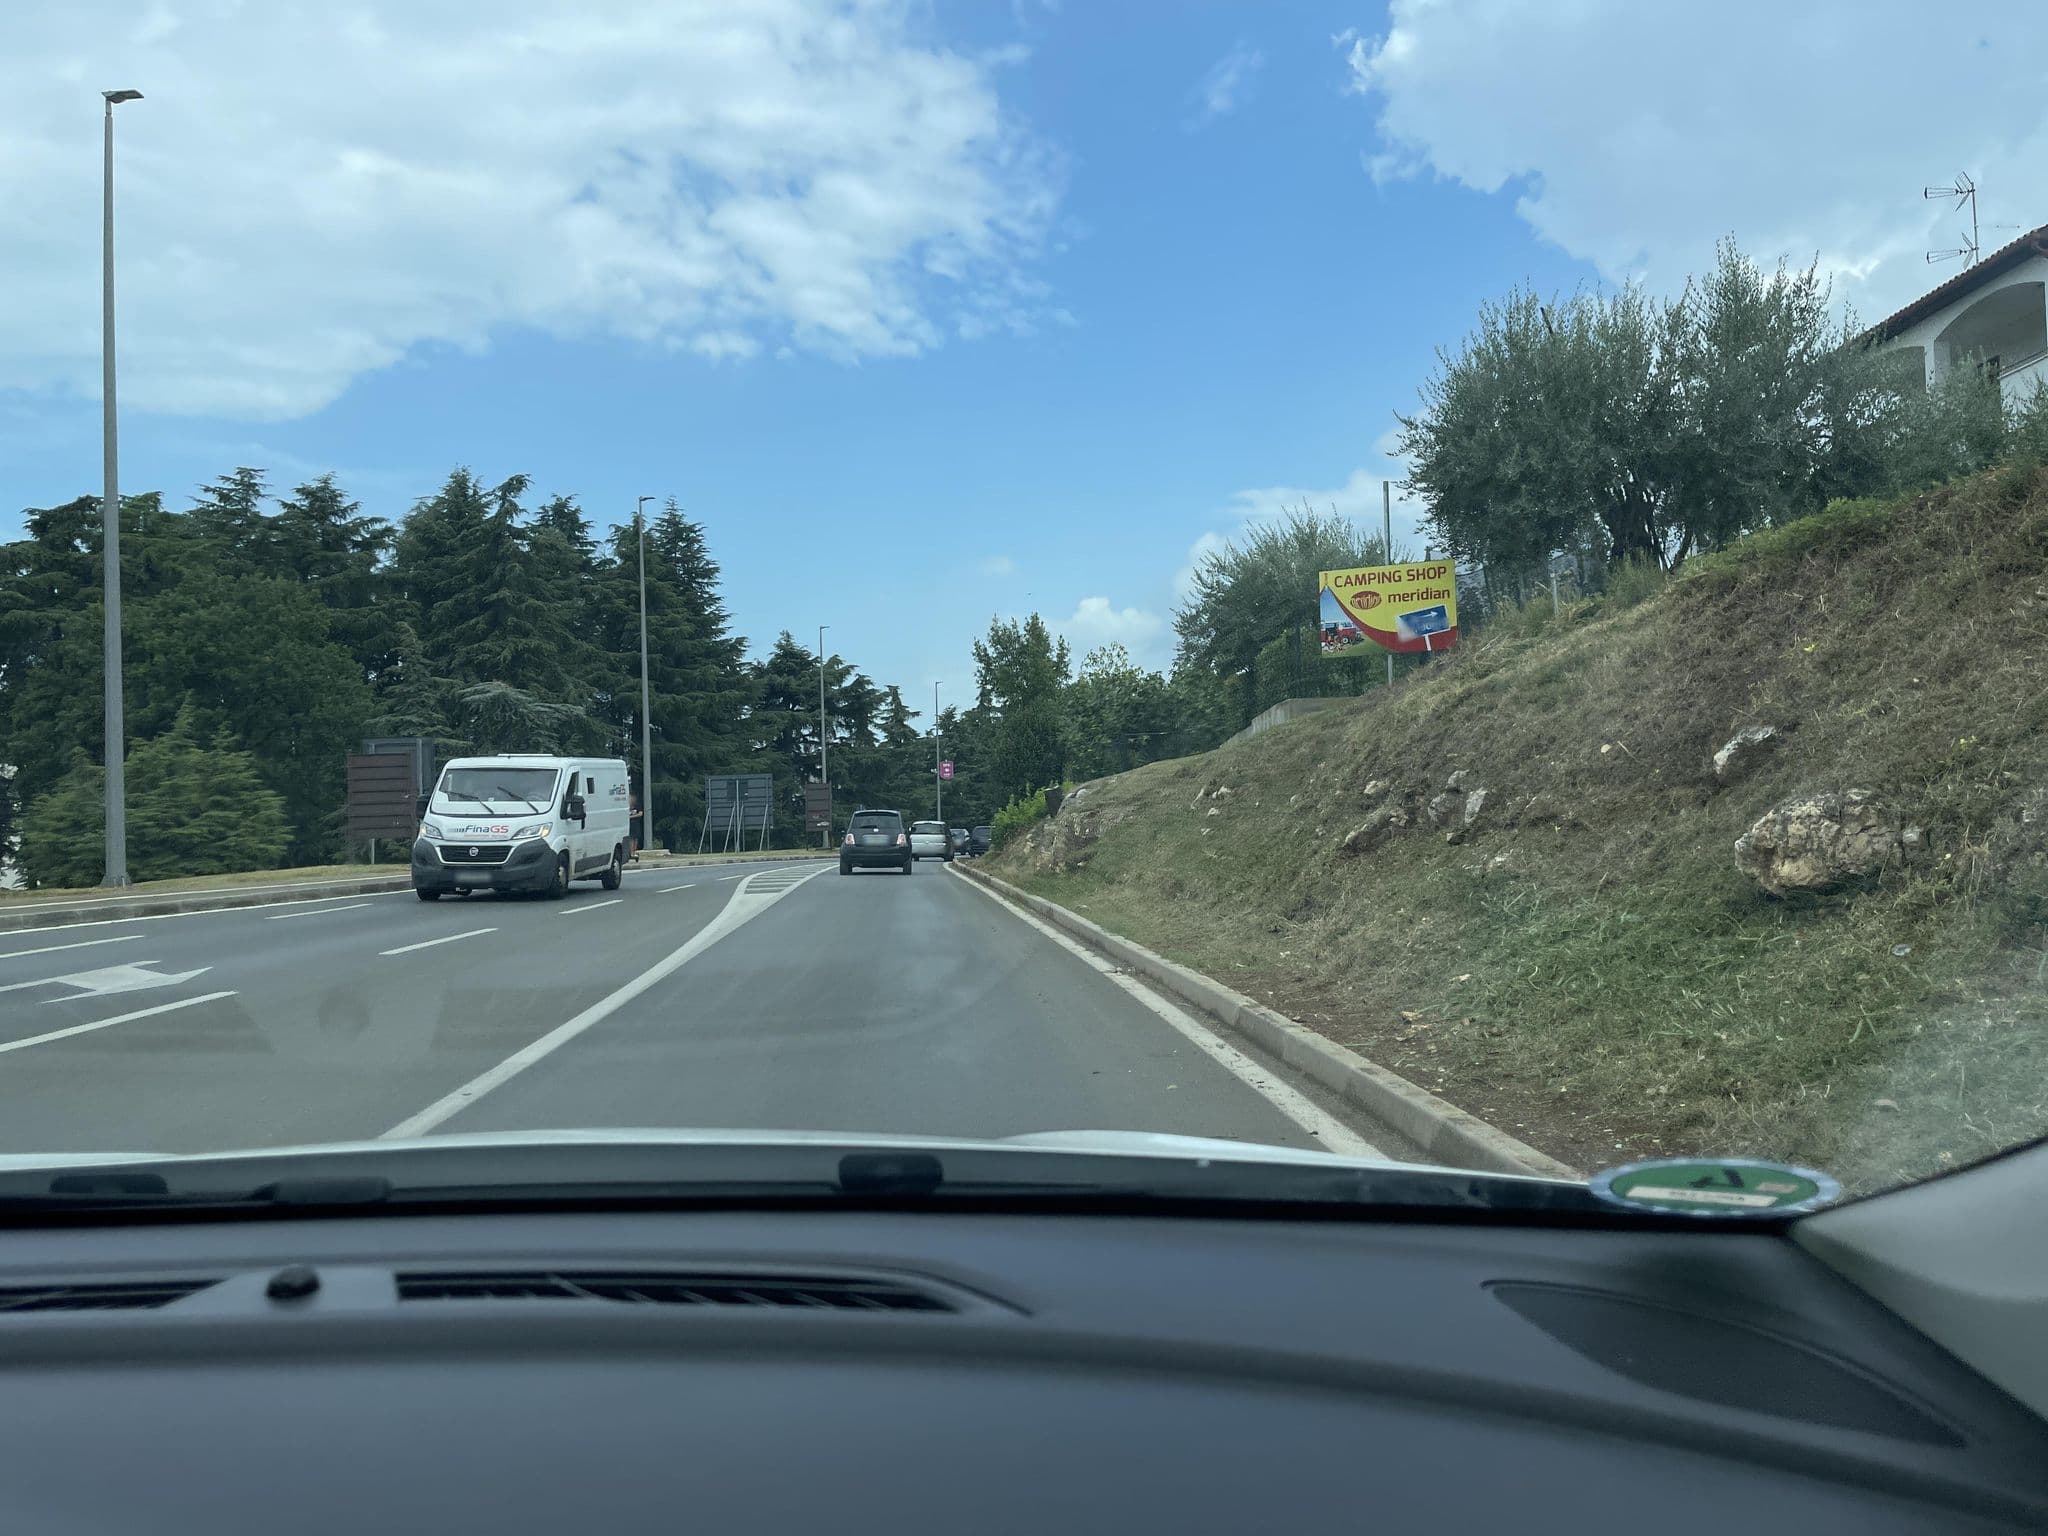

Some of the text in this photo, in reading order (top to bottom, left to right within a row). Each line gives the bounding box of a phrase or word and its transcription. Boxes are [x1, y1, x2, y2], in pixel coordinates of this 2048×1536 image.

[1335, 566, 1447, 588] CAMPING SHOP
[1388, 587, 1450, 603] meridian
[465, 825, 509, 834] FinaGS
